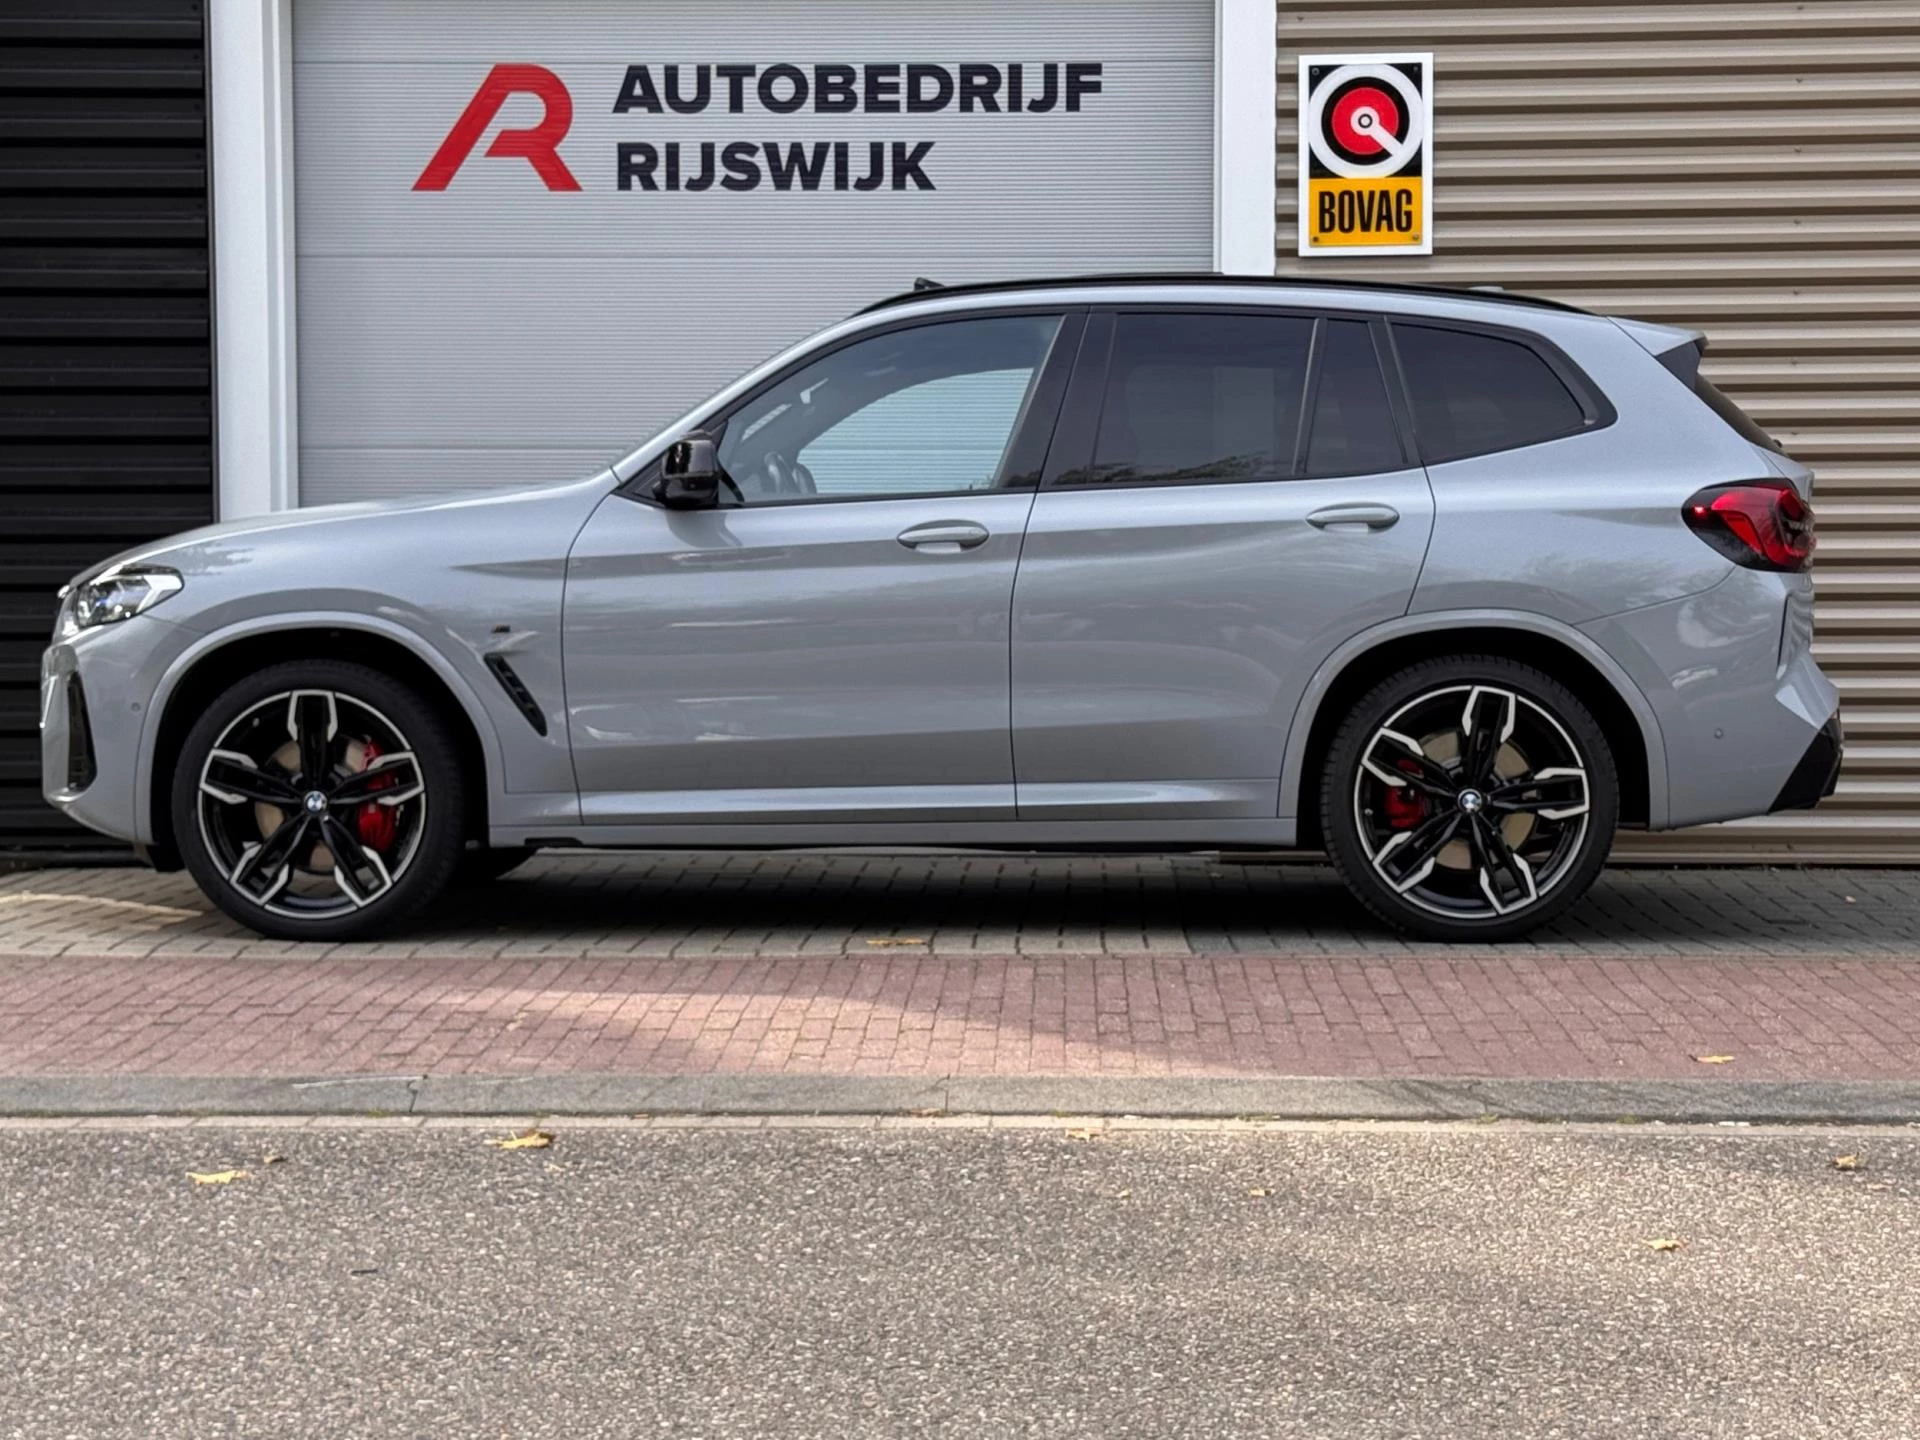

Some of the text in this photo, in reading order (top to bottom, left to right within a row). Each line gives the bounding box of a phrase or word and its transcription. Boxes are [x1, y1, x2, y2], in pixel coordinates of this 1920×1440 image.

[612, 63, 1103, 114] AUTOBEDRIJF
[616, 141, 936, 192] RIJSWIJK
[1318, 188, 1413, 234] BOVAG
